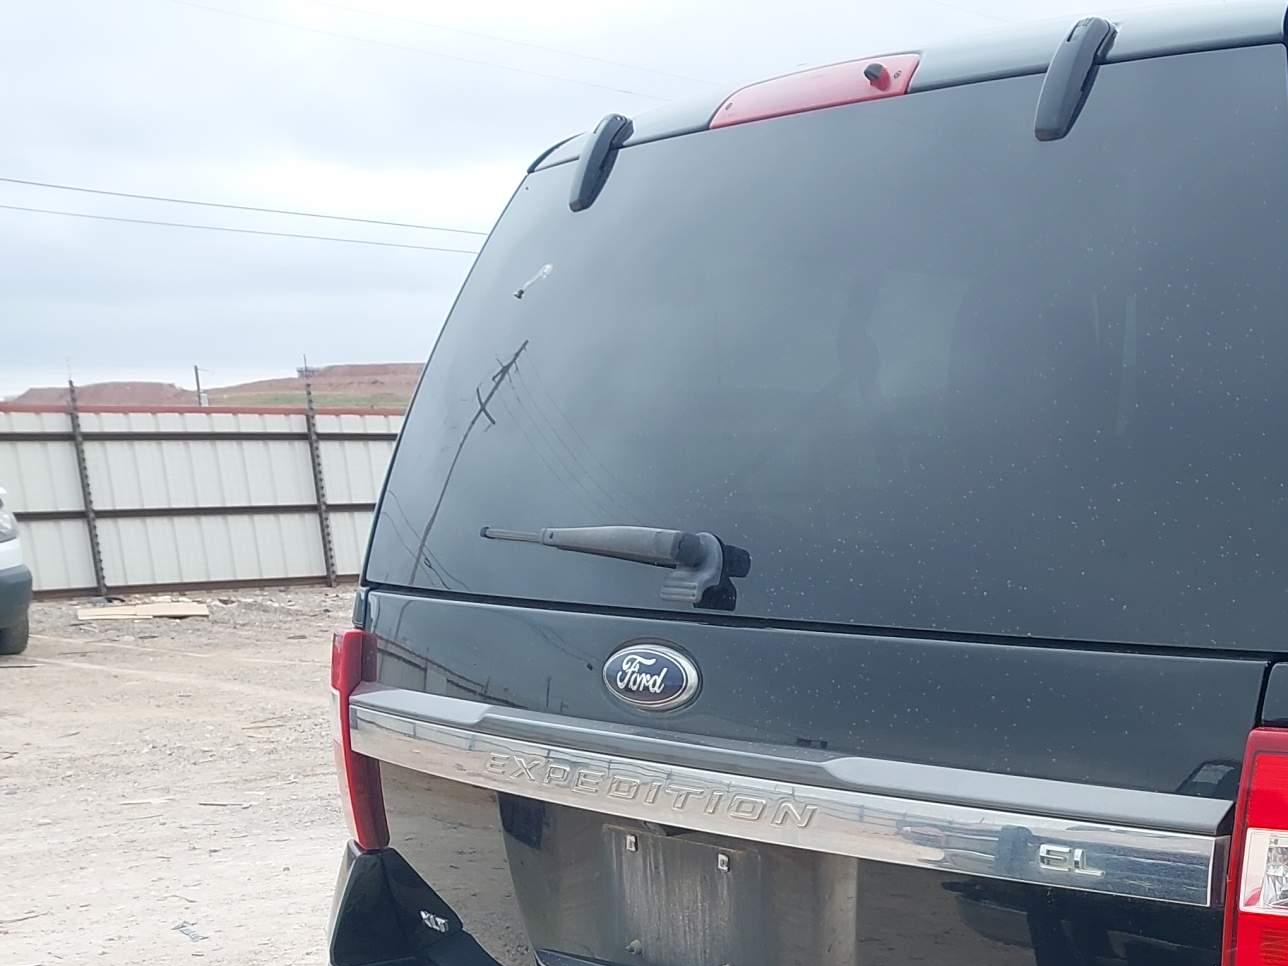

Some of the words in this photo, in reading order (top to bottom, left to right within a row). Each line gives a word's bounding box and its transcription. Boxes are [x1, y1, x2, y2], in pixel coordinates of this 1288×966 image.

[616, 654, 665, 693] Ford
[485, 752, 820, 829] EXPEDITION
[420, 910, 448, 933] XLT
